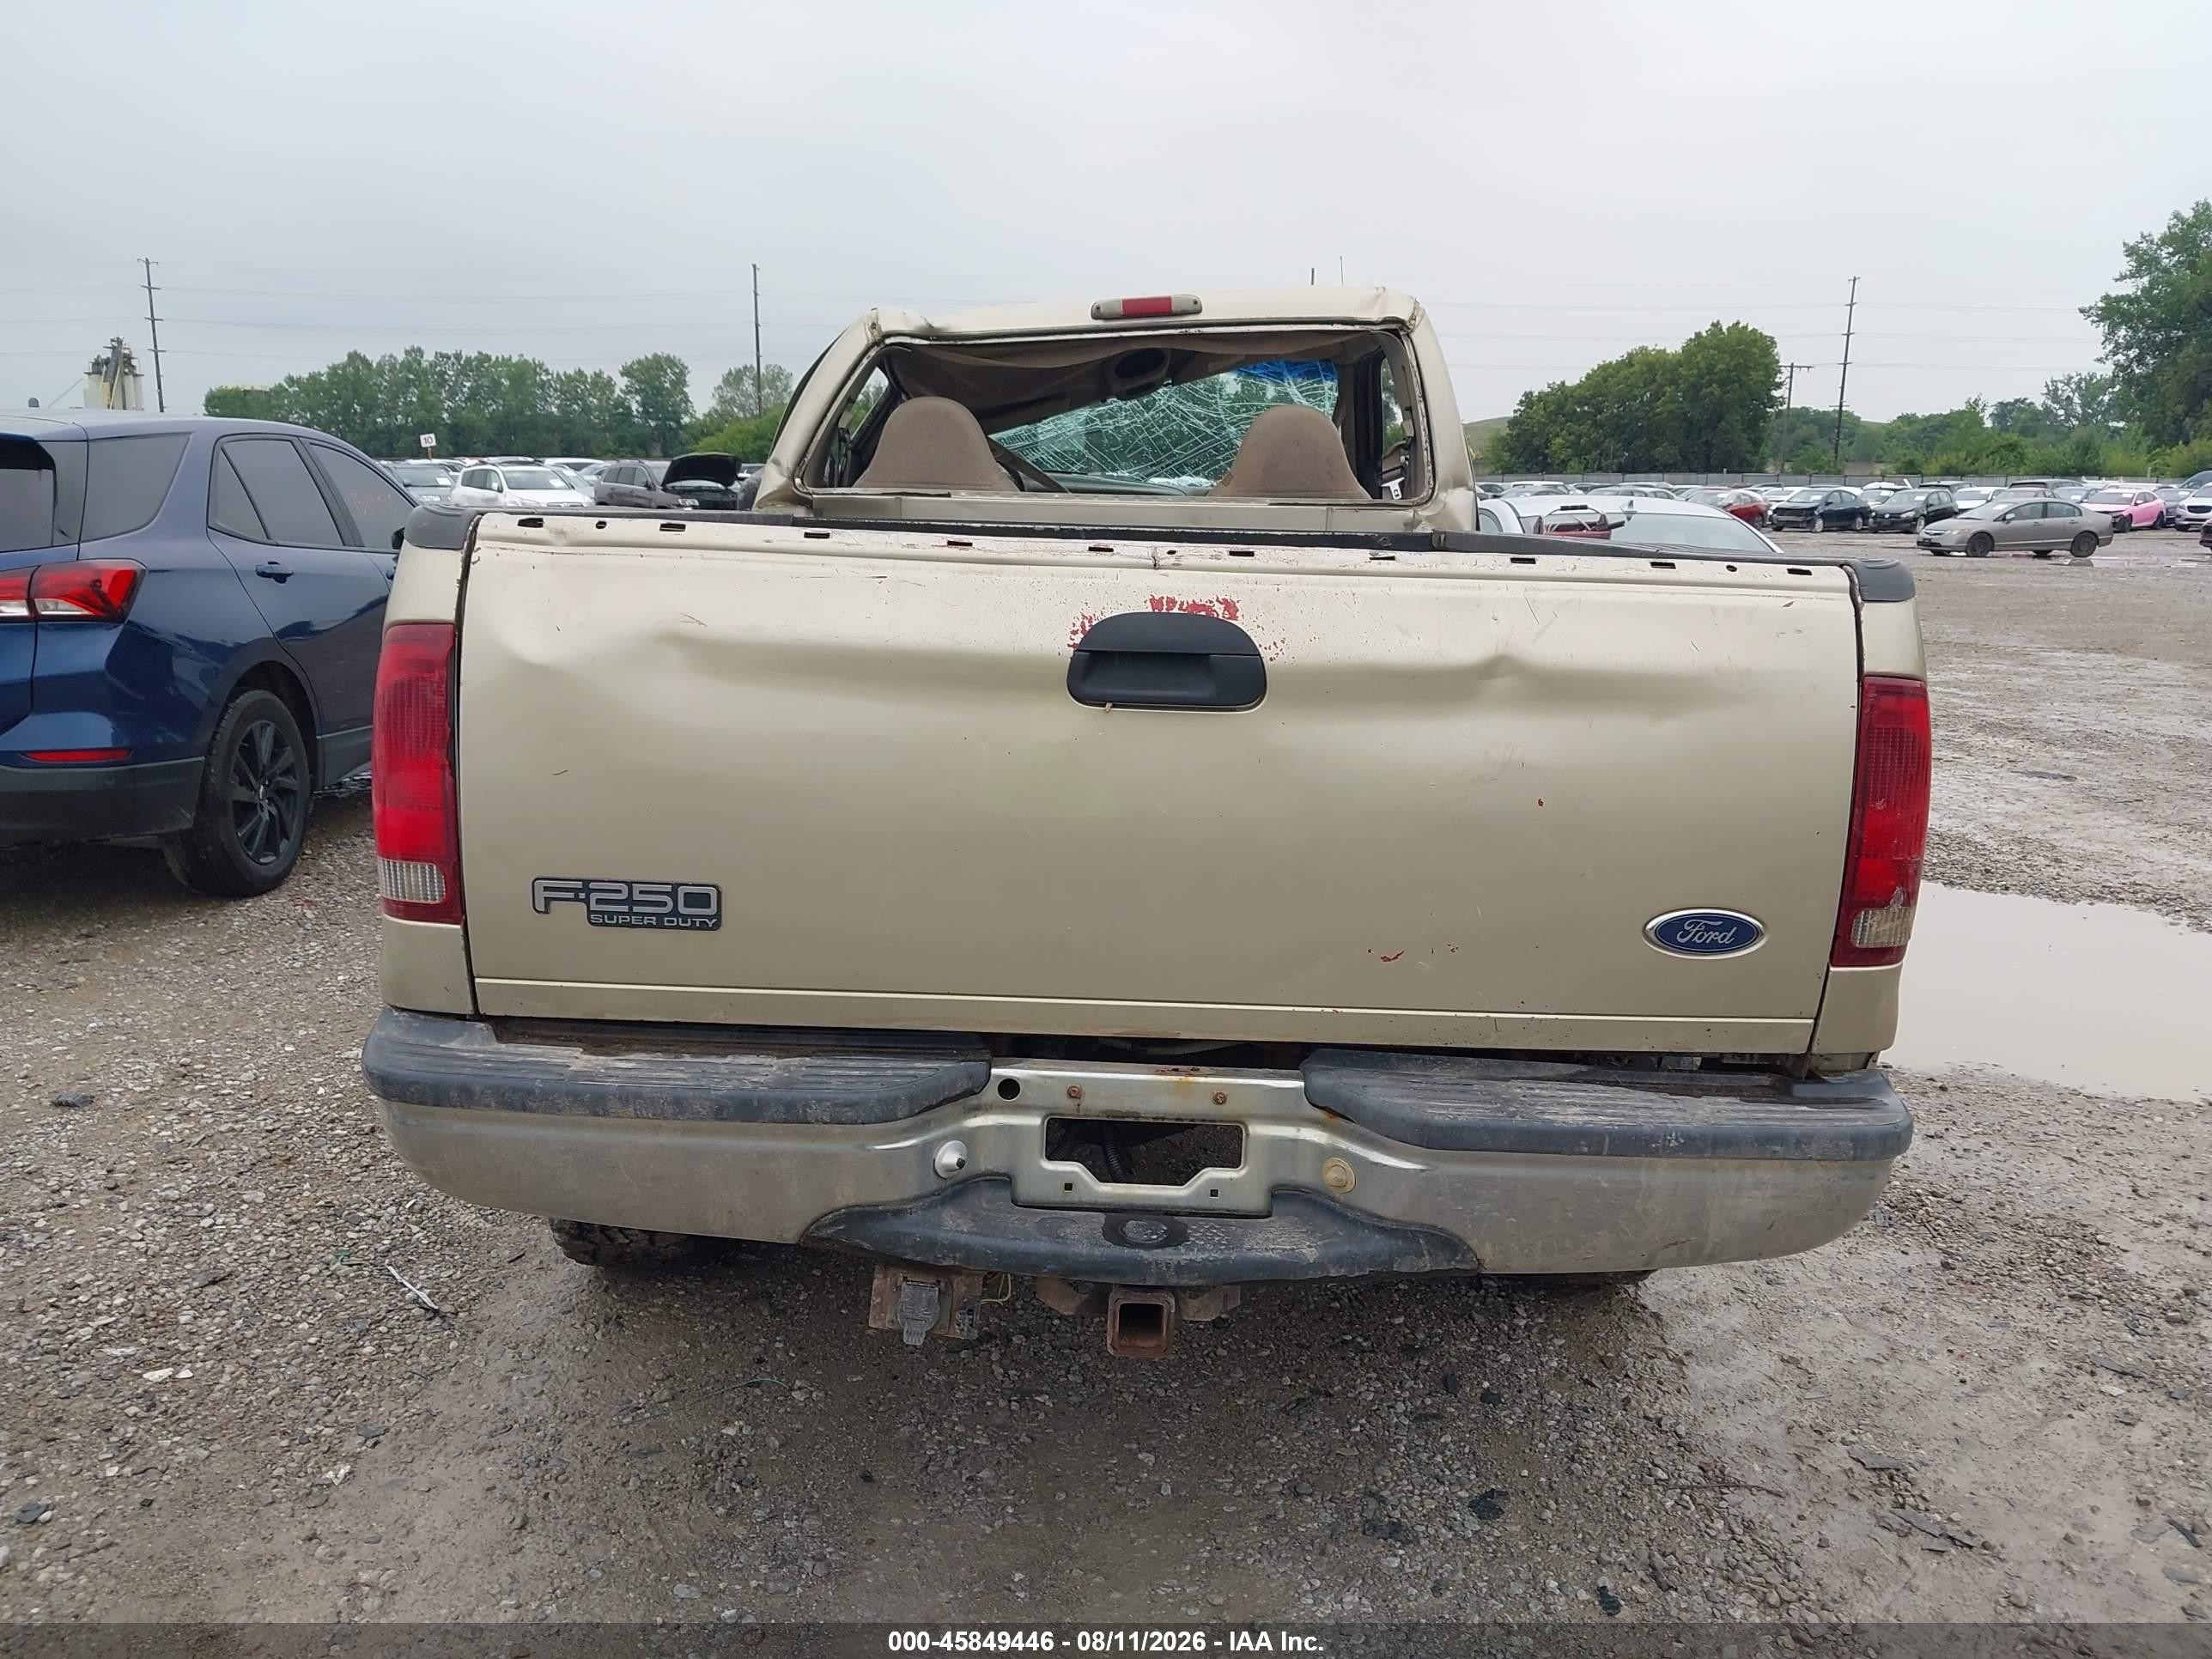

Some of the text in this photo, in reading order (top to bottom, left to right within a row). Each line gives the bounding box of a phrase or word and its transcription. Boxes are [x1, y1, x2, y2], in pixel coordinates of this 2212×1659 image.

[589, 914, 718, 927] SUPER DUTY
[1676, 919, 1738, 945] Ford
